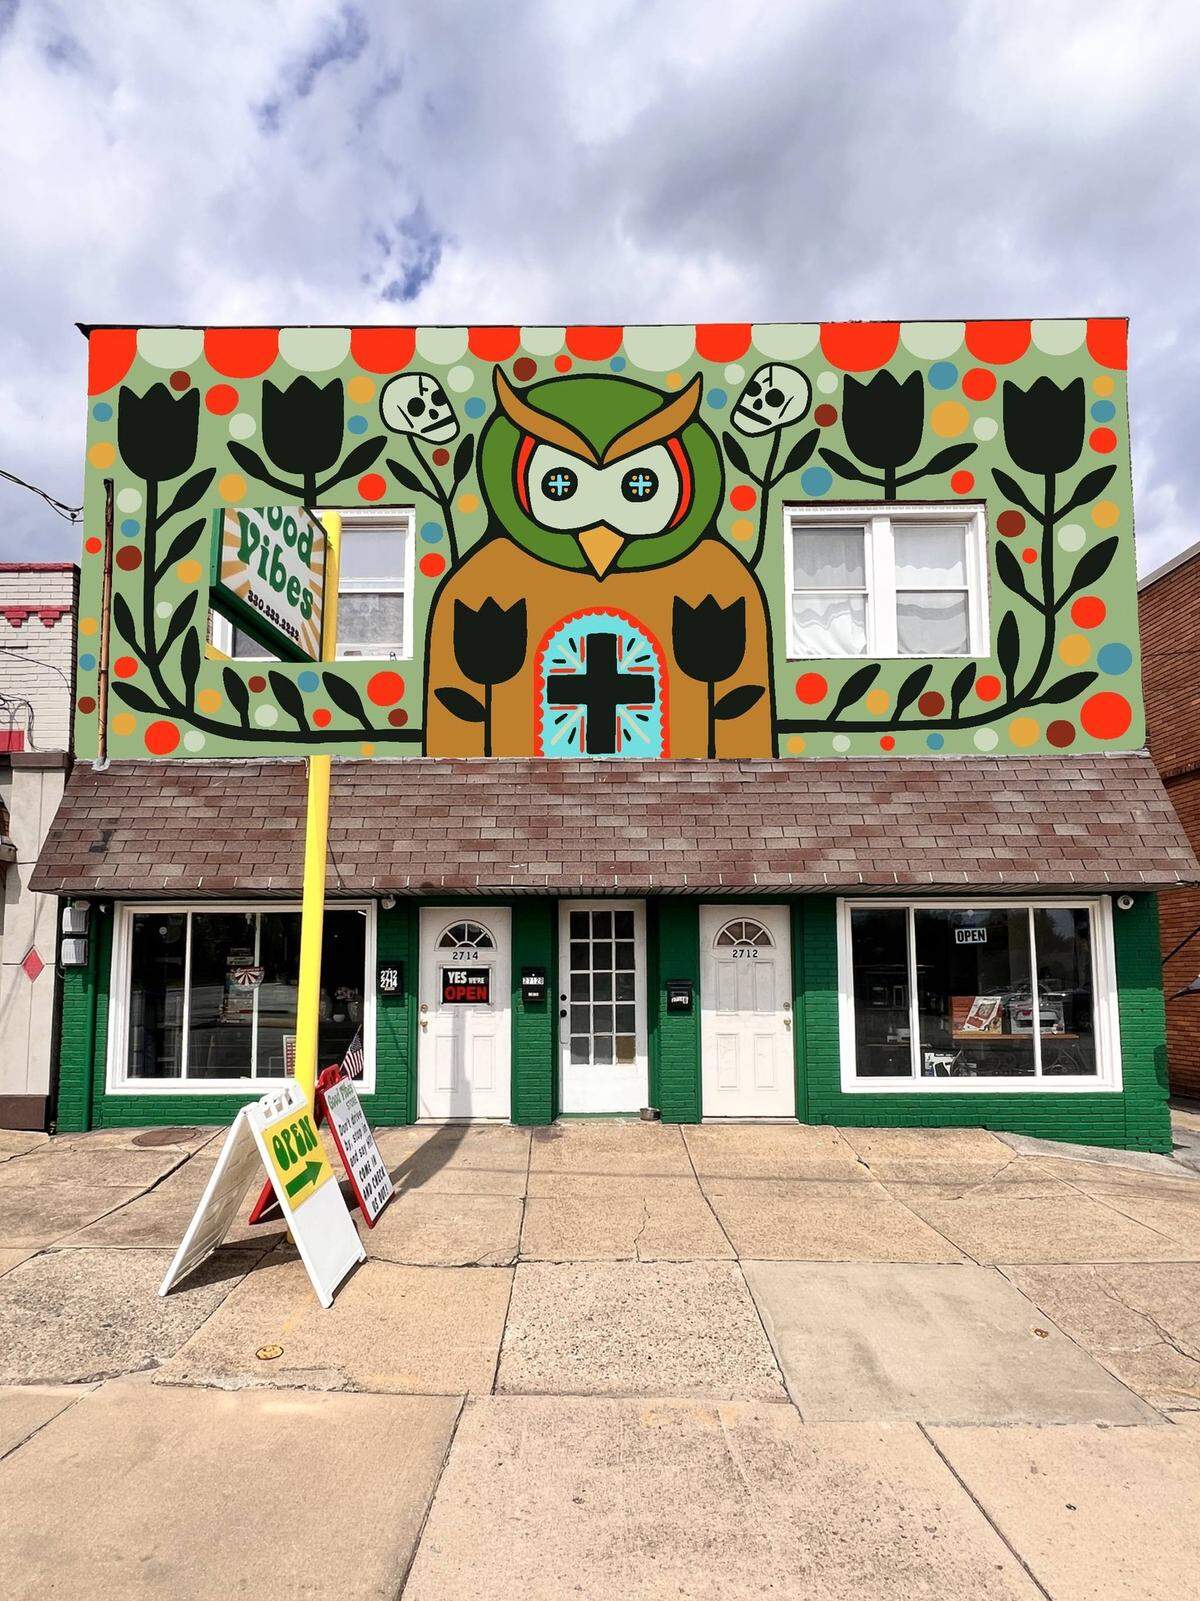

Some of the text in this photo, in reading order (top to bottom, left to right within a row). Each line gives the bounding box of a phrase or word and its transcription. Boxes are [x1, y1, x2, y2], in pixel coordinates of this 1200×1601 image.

[253, 506, 314, 569] ood
[237, 512, 314, 620] Vibes
[957, 930, 986, 942] OPEN
[452, 951, 478, 960] 2714
[732, 949, 758, 959] 2712
[380, 970, 398, 980] 2712
[447, 971, 467, 984] YES
[380, 979, 398, 988] 2714
[444, 986, 488, 1000] OPEN
[338, 1118, 352, 1136] Don't
[272, 1115, 318, 1171] OPEN
[350, 1150, 359, 1167] and
[359, 1154, 377, 1182] COME IN
[363, 1166, 386, 1201] AND CHECK
[371, 1197, 379, 1213] US
